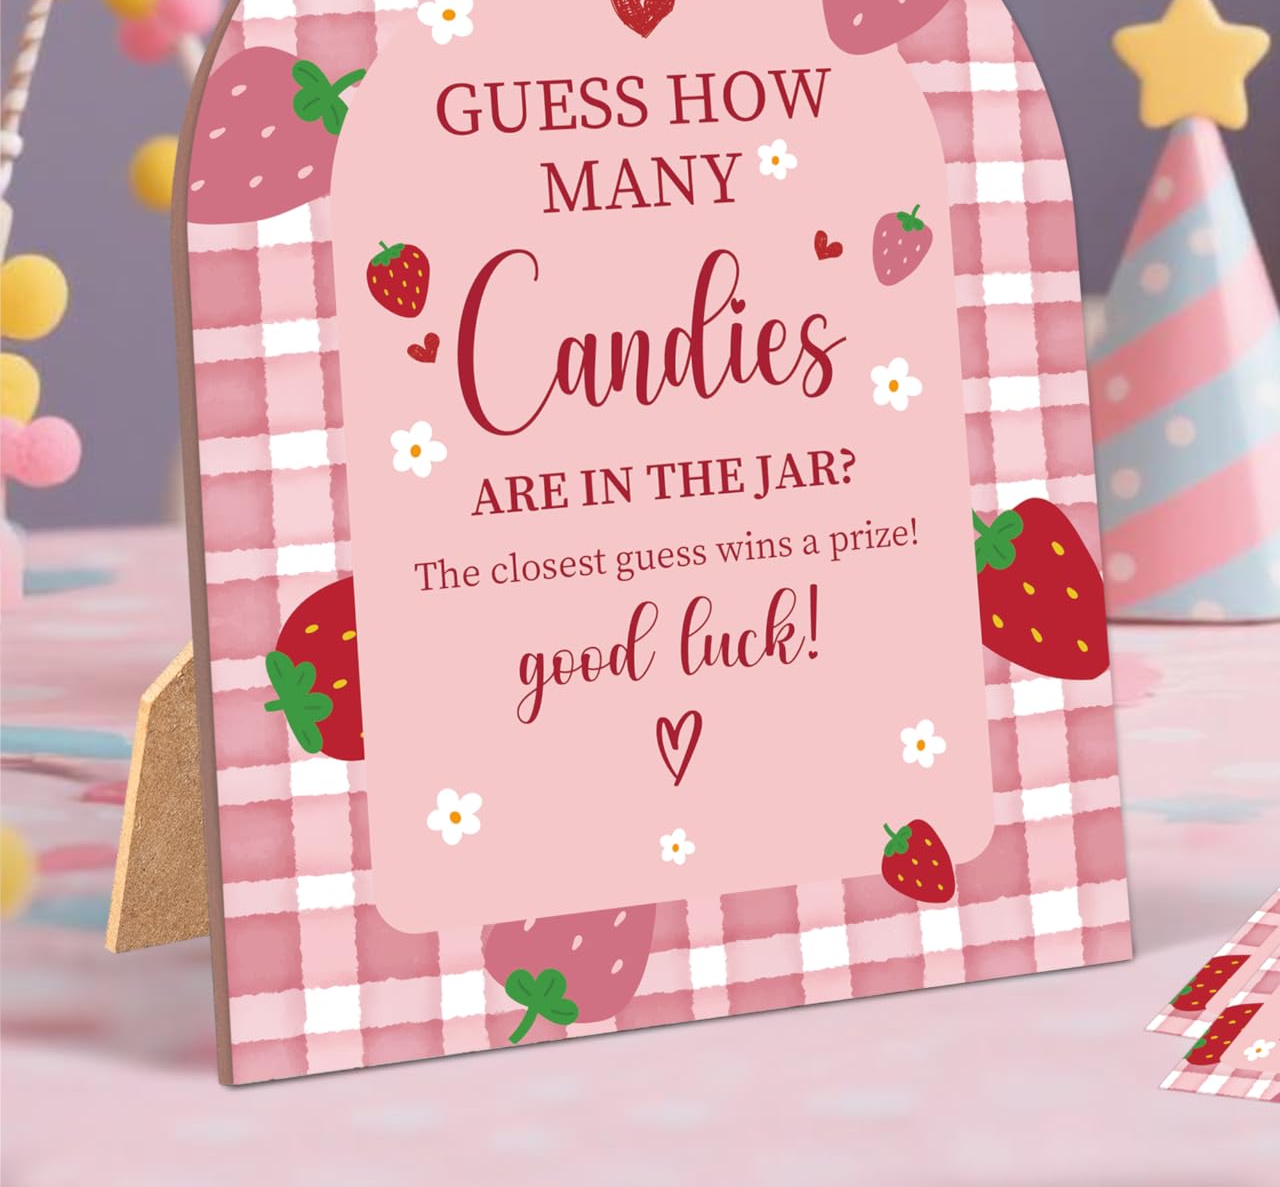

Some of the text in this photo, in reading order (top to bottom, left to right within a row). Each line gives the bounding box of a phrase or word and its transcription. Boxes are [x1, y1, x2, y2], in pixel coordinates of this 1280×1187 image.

[435, 67, 833, 137] GUESS HOW
[539, 151, 744, 214] MANY
[456, 248, 848, 437] Candies
[470, 447, 857, 517] ARE IN THE JAR?
[413, 516, 918, 592] The closest guess wins a prize!
[516, 583, 819, 725] good luck!
